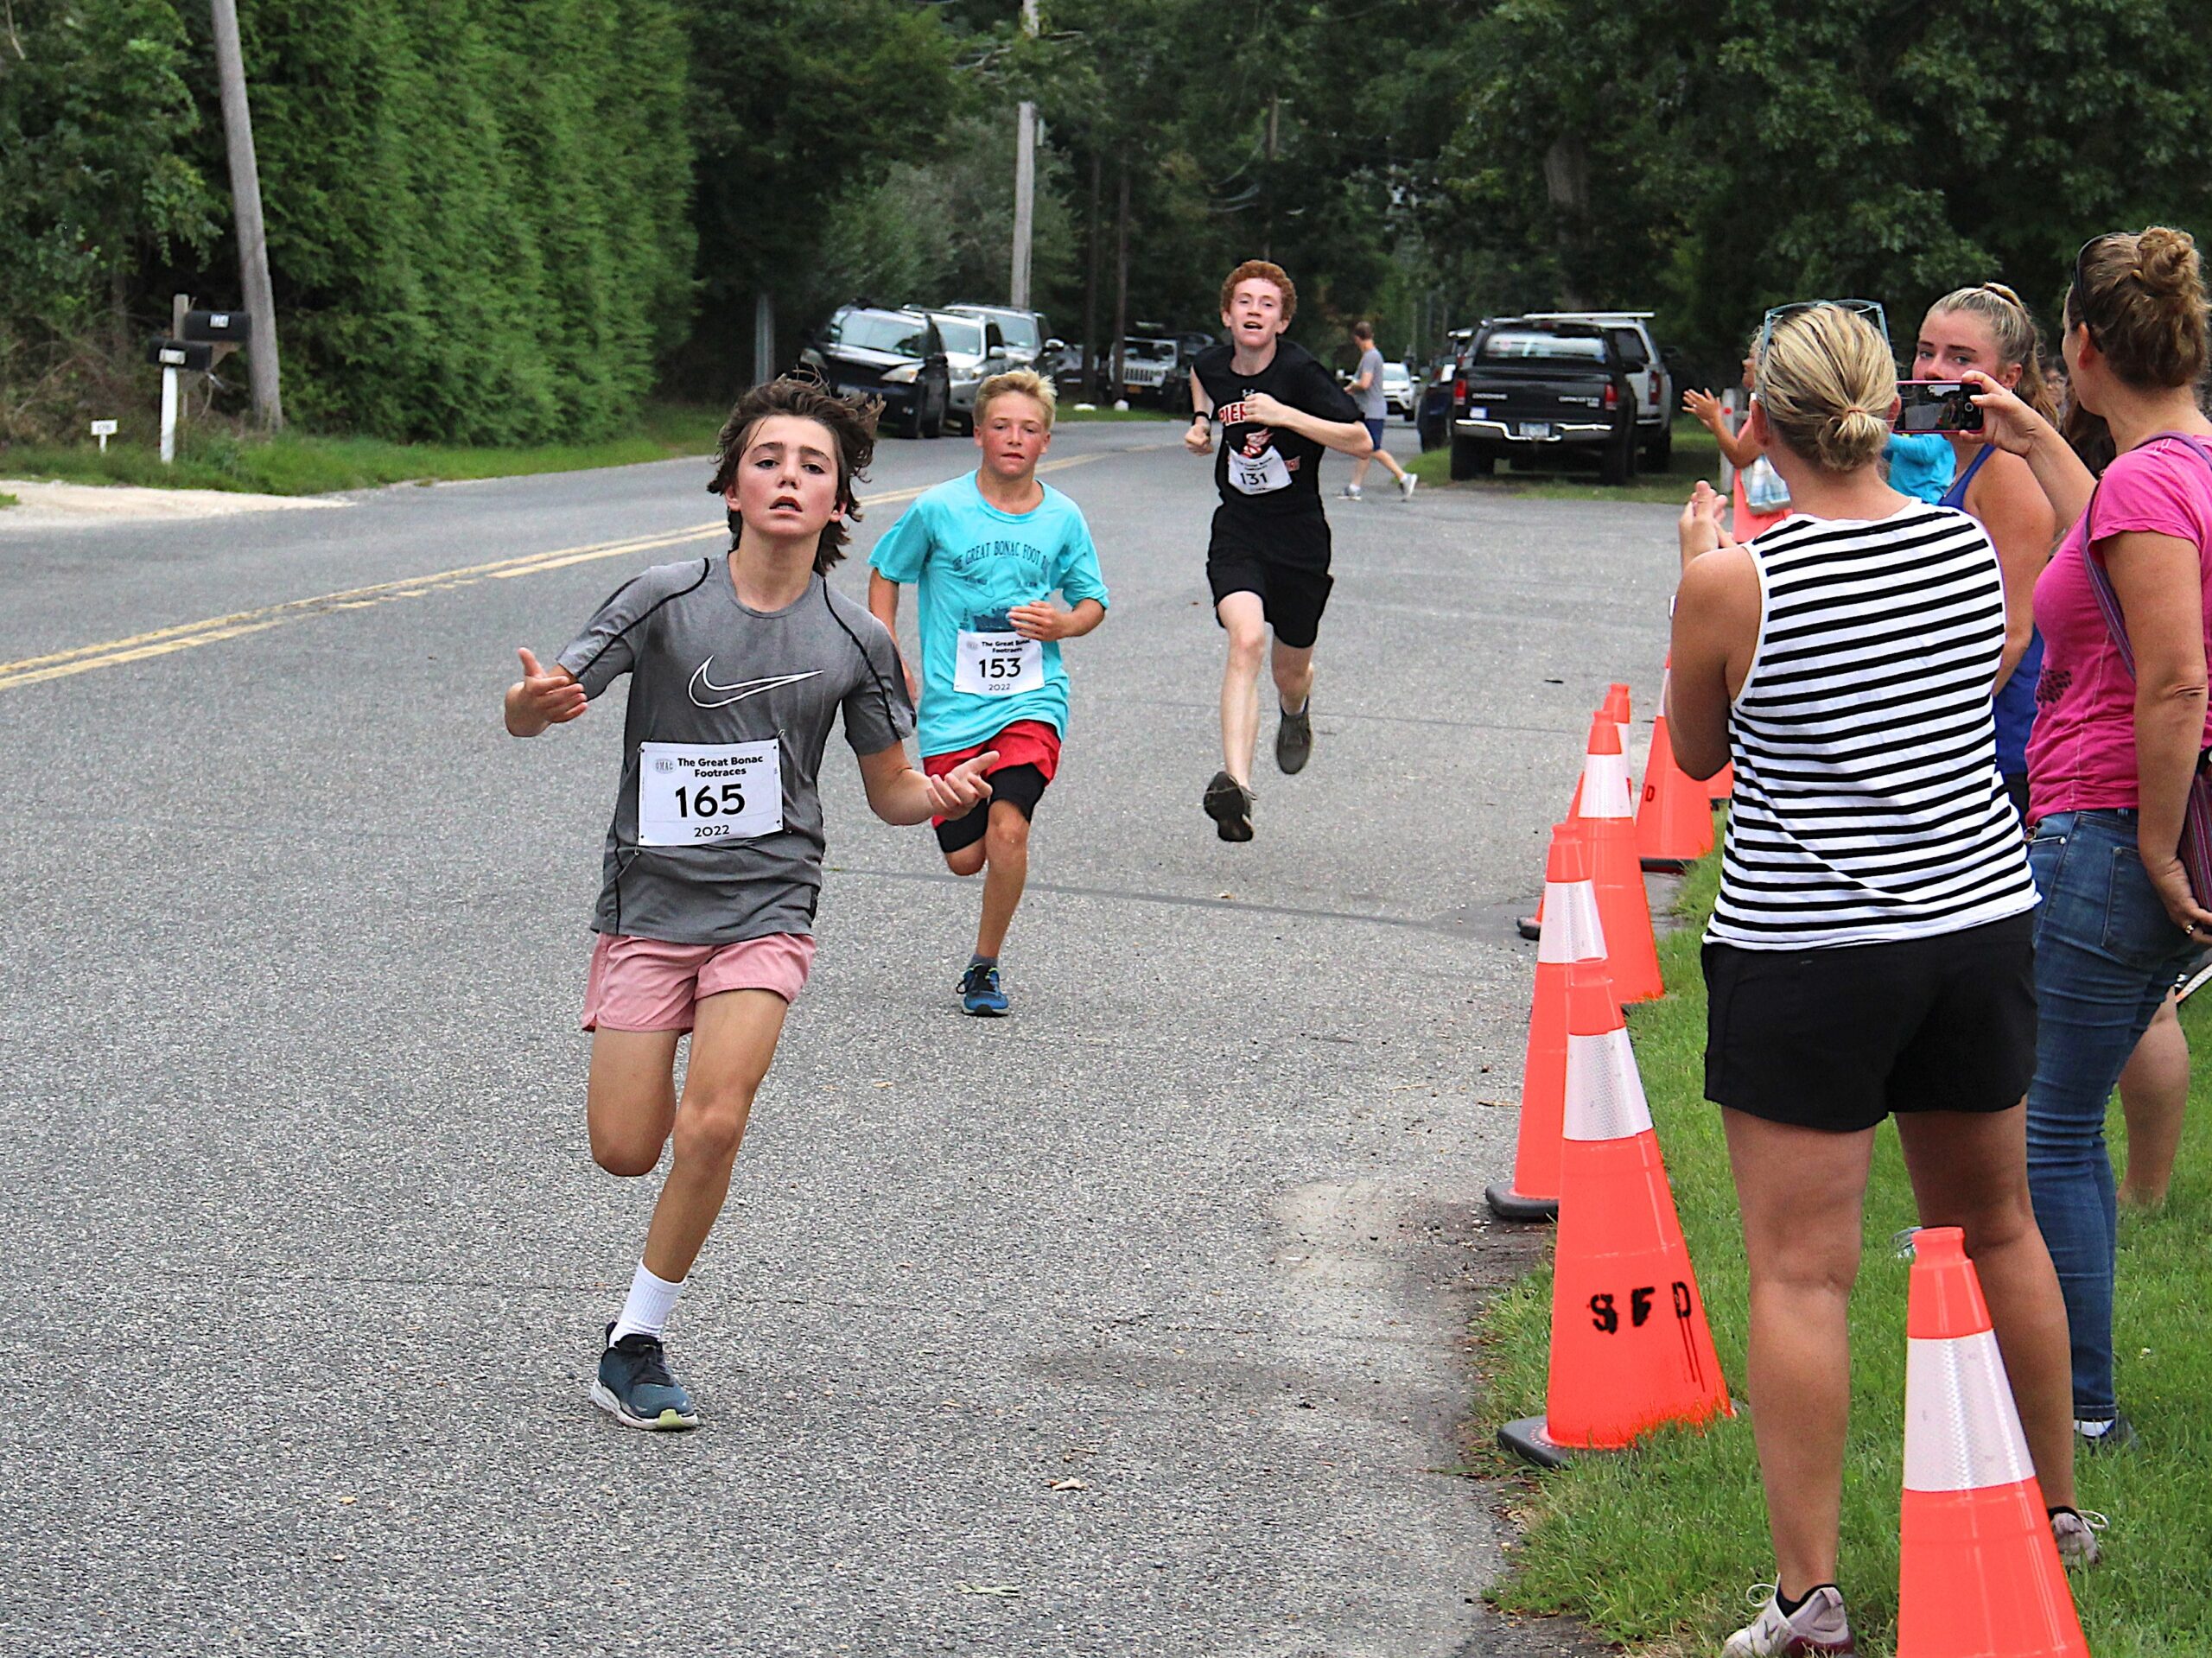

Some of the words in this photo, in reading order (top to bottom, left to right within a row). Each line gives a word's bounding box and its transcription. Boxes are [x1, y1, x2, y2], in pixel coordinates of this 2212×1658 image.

[1240, 473, 1268, 485] 131
[965, 543, 990, 565] GREAT
[994, 541, 1020, 556] BONAC
[1022, 543, 1041, 565] FOOT
[979, 657, 1021, 678] 153
[677, 758, 696, 767] The
[698, 757, 728, 767] Great
[731, 755, 764, 765] Bonac
[695, 768, 747, 778] Footraces
[675, 784, 746, 817] 165
[694, 825, 730, 837] 2022
